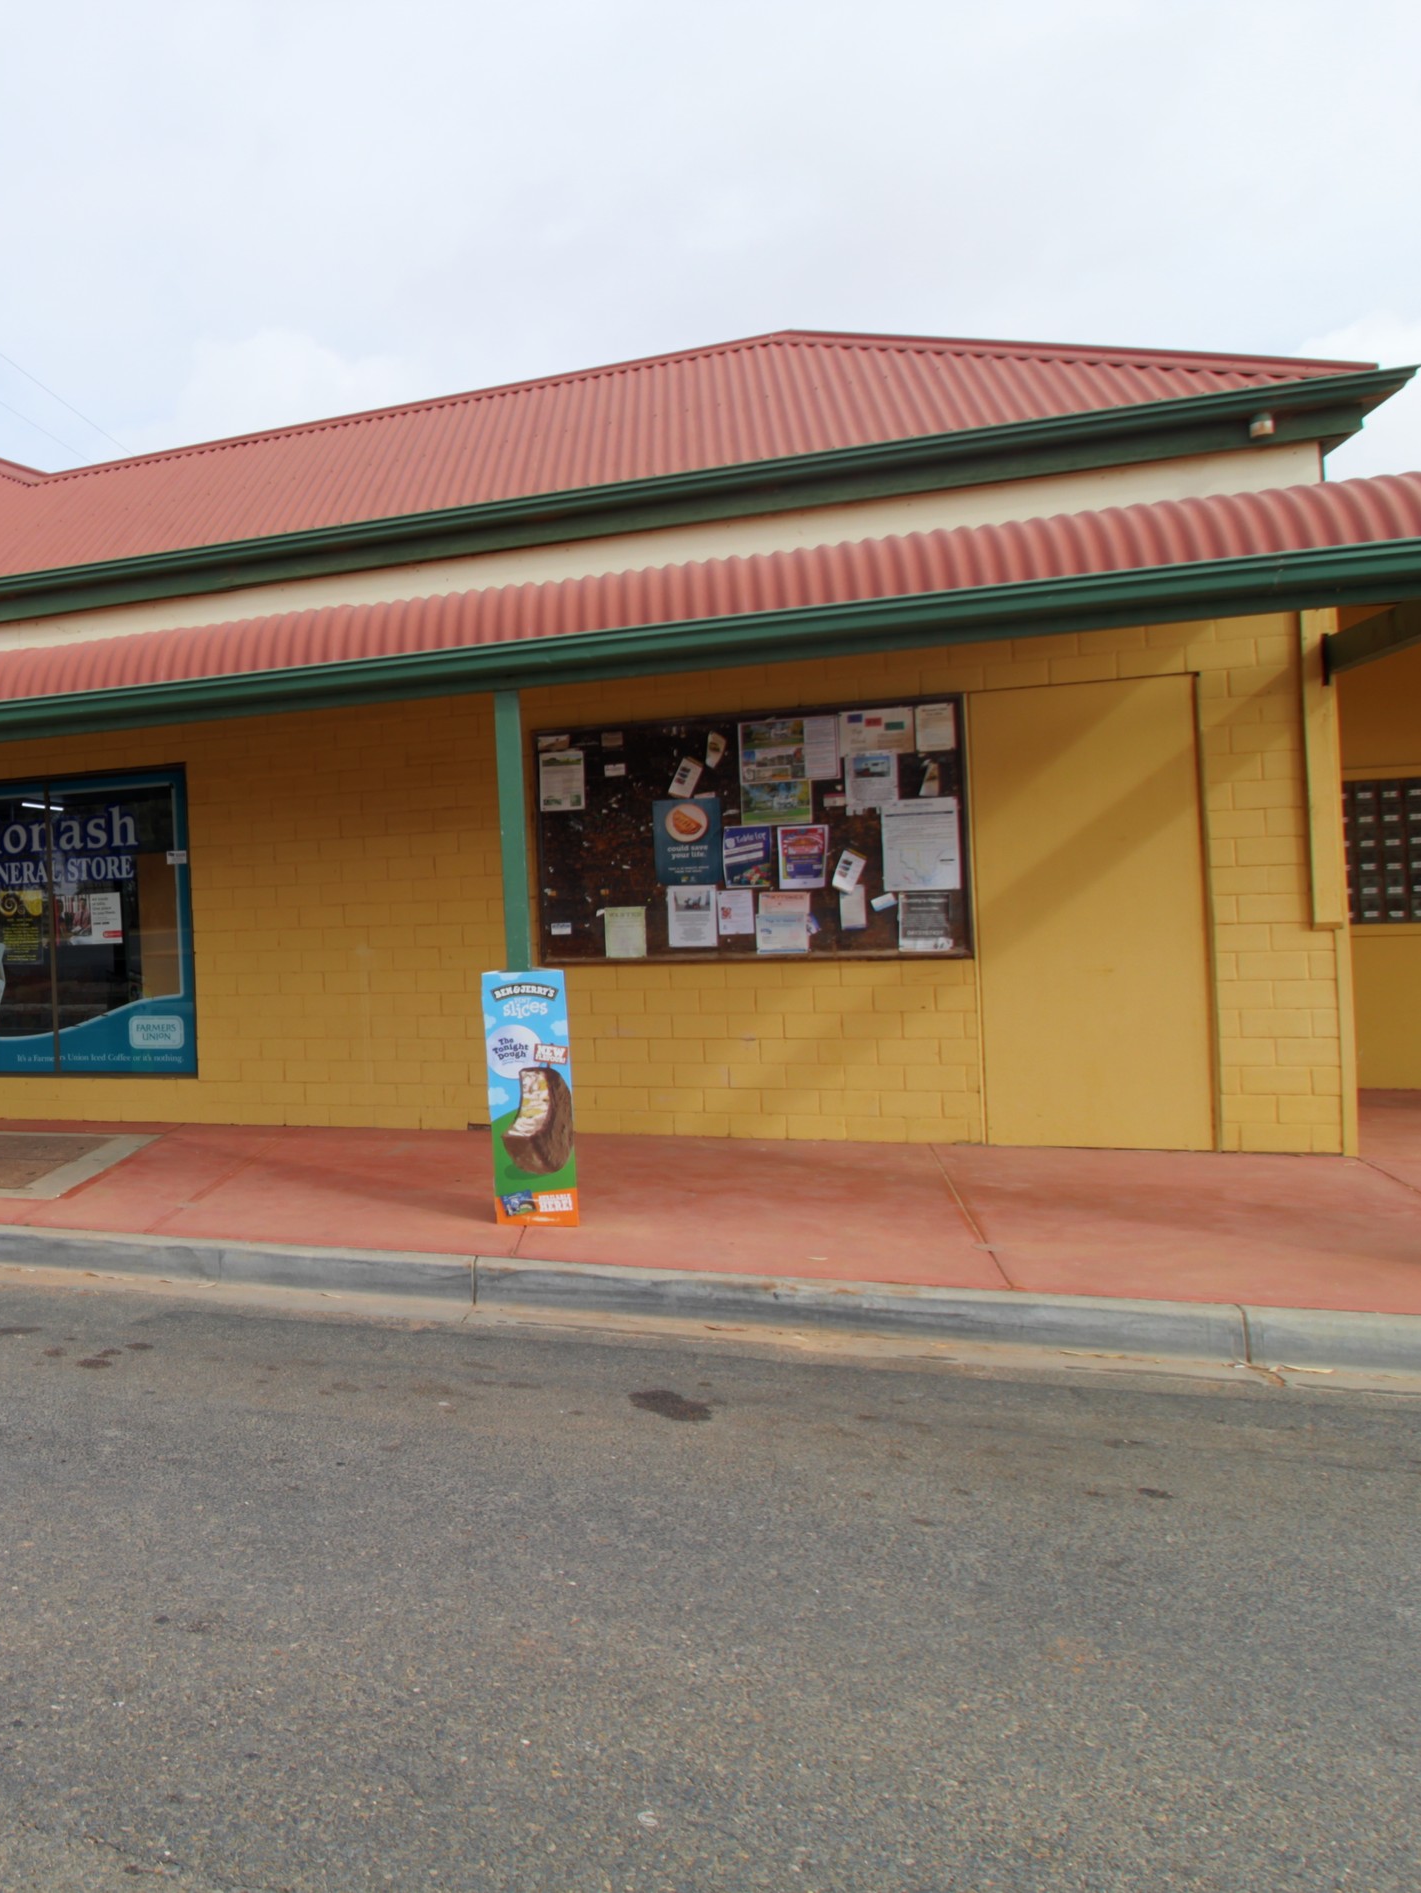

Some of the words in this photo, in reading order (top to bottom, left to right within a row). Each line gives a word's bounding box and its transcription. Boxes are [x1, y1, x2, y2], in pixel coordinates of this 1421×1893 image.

[671, 852, 689, 860] your
[67, 855, 135, 881] STORE
[502, 1000, 549, 1019] slices
[135, 1023, 177, 1033] FARMERS
[141, 1033, 171, 1042] UNION
[498, 1037, 514, 1046] The
[492, 1043, 529, 1054] Tonight
[536, 1045, 567, 1058] NEW
[16, 1053, 27, 1062] It's
[67, 1053, 90, 1062] Union
[91, 1053, 107, 1062] Iced
[107, 1052, 132, 1062] Coffee
[142, 1053, 153, 1062] it's
[497, 1050, 527, 1060] Dough
